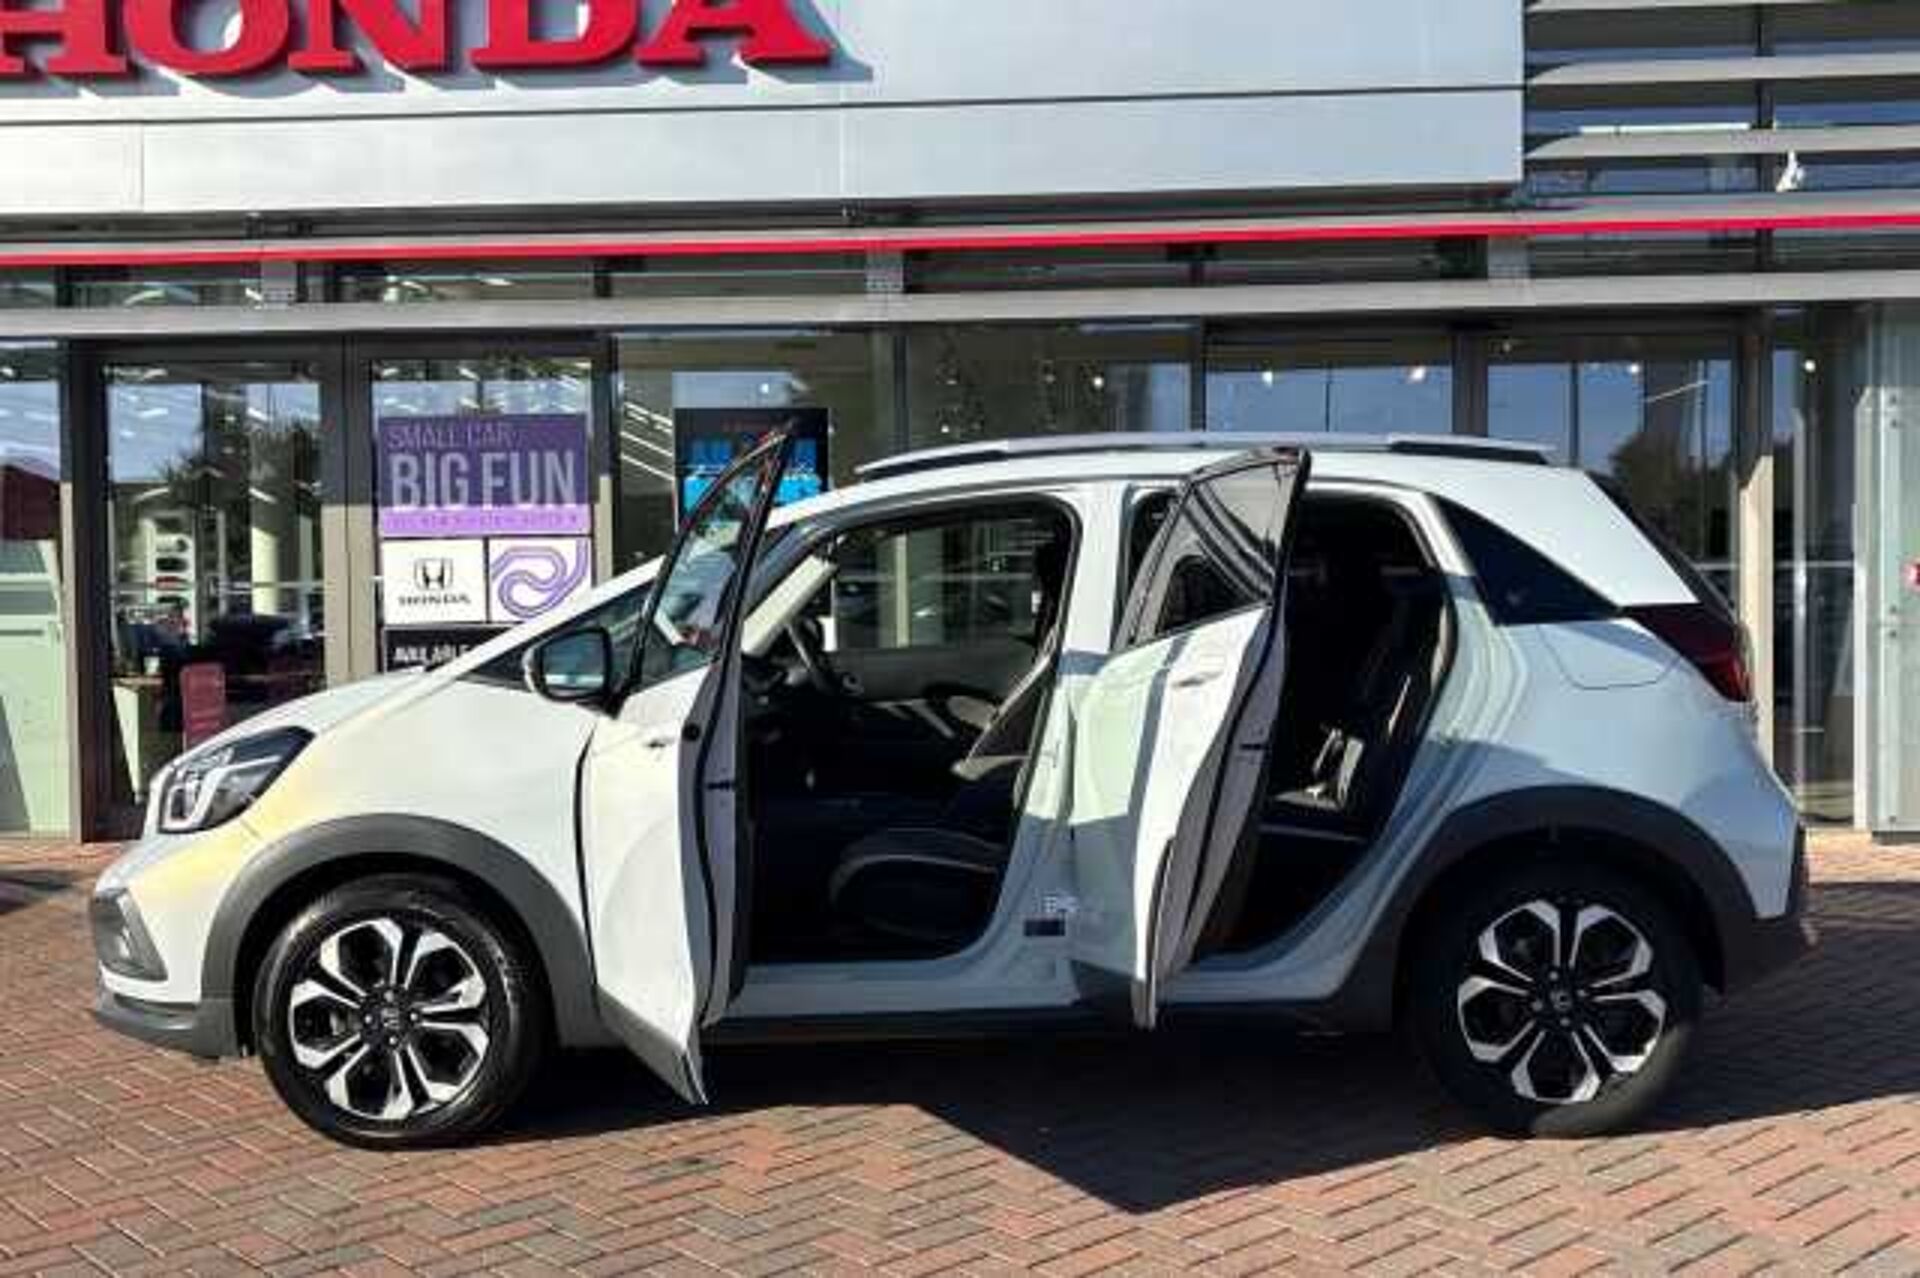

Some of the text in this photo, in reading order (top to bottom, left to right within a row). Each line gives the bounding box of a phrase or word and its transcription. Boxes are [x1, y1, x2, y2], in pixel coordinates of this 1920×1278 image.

[386, 424, 465, 449] SMALL
[390, 451, 576, 511] BIG FUN
